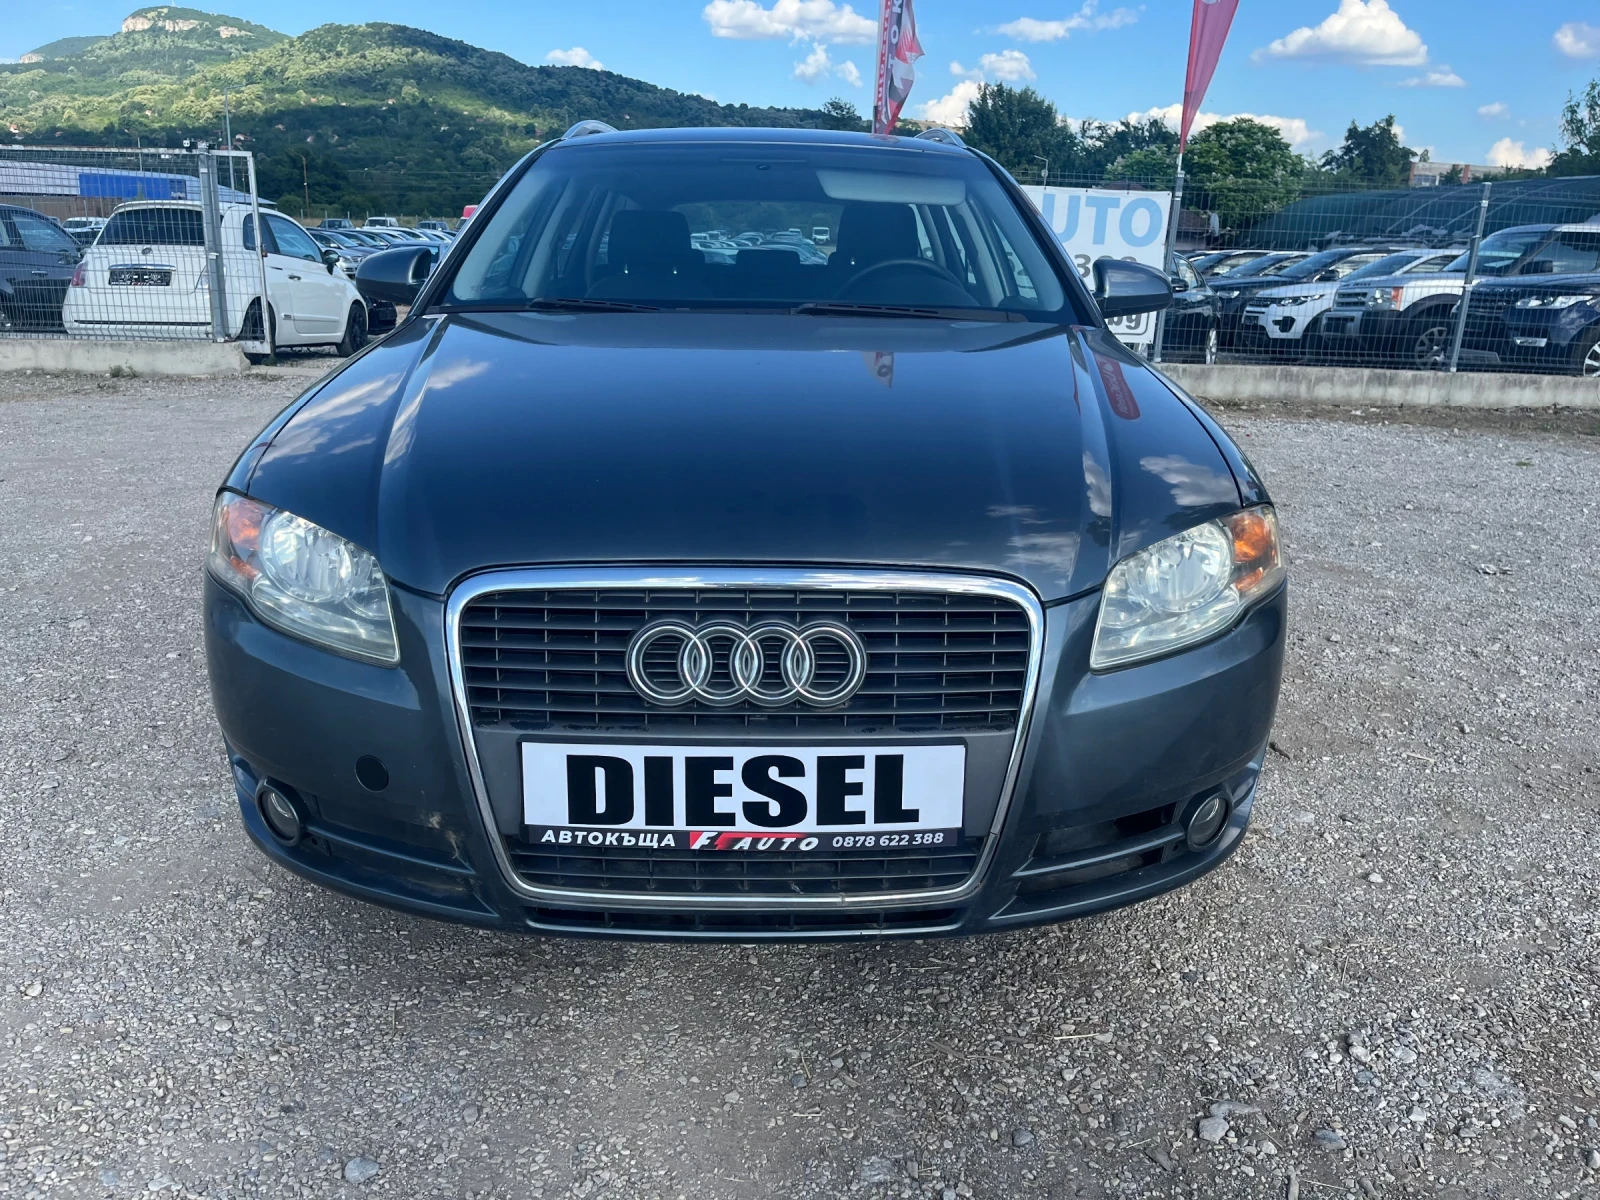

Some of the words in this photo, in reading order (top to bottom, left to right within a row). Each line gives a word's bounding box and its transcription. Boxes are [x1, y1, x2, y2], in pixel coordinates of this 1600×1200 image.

[566, 754, 920, 827] DIESEL
[541, 830, 675, 848] АВТОКЪЩА
[733, 837, 819, 851] AUTO
[832, 835, 876, 848] 0878
[879, 834, 909, 846] 622
[912, 832, 944, 845] 388
